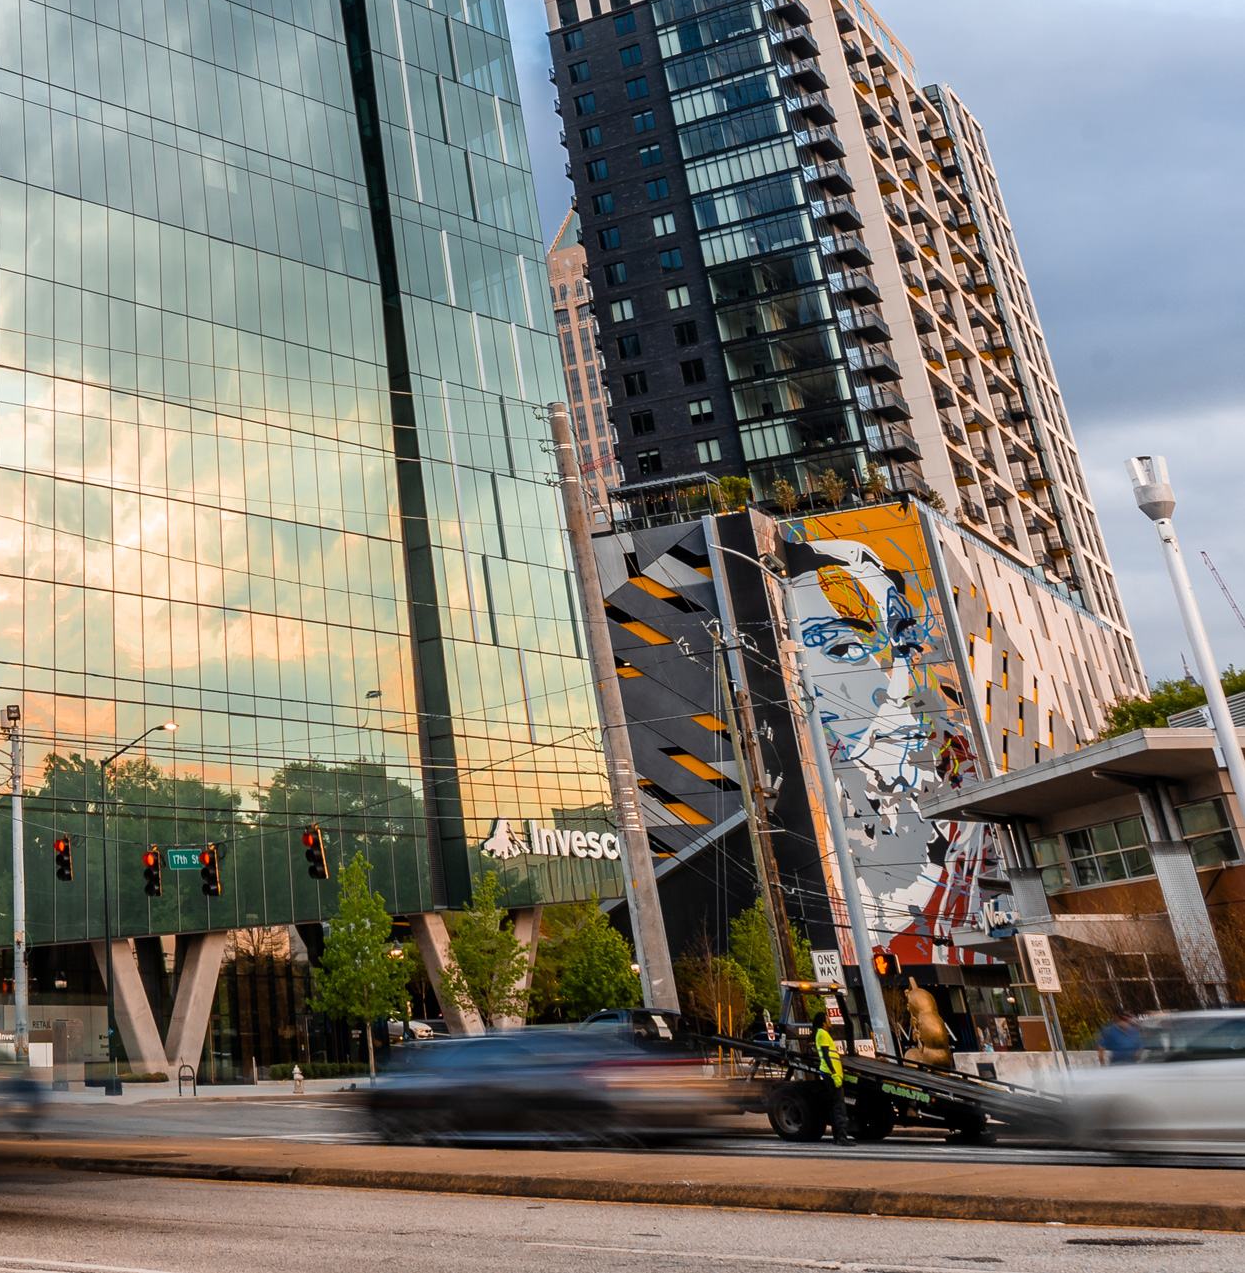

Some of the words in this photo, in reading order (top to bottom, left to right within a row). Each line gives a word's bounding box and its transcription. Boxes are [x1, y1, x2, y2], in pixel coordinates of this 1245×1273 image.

[529, 819, 621, 860] Invesc
[172, 854, 188, 865] 17th
[191, 854, 200, 865] St
[1030, 939, 1044, 947] RIGHT
[1034, 949, 1046, 957] TURN
[817, 954, 836, 965] ONE
[1033, 958, 1041, 966] ON
[1041, 958, 1051, 966] RED
[818, 966, 838, 977] WAY
[1038, 967, 1052, 975] AFTER
[1041, 976, 1053, 984] STOP
